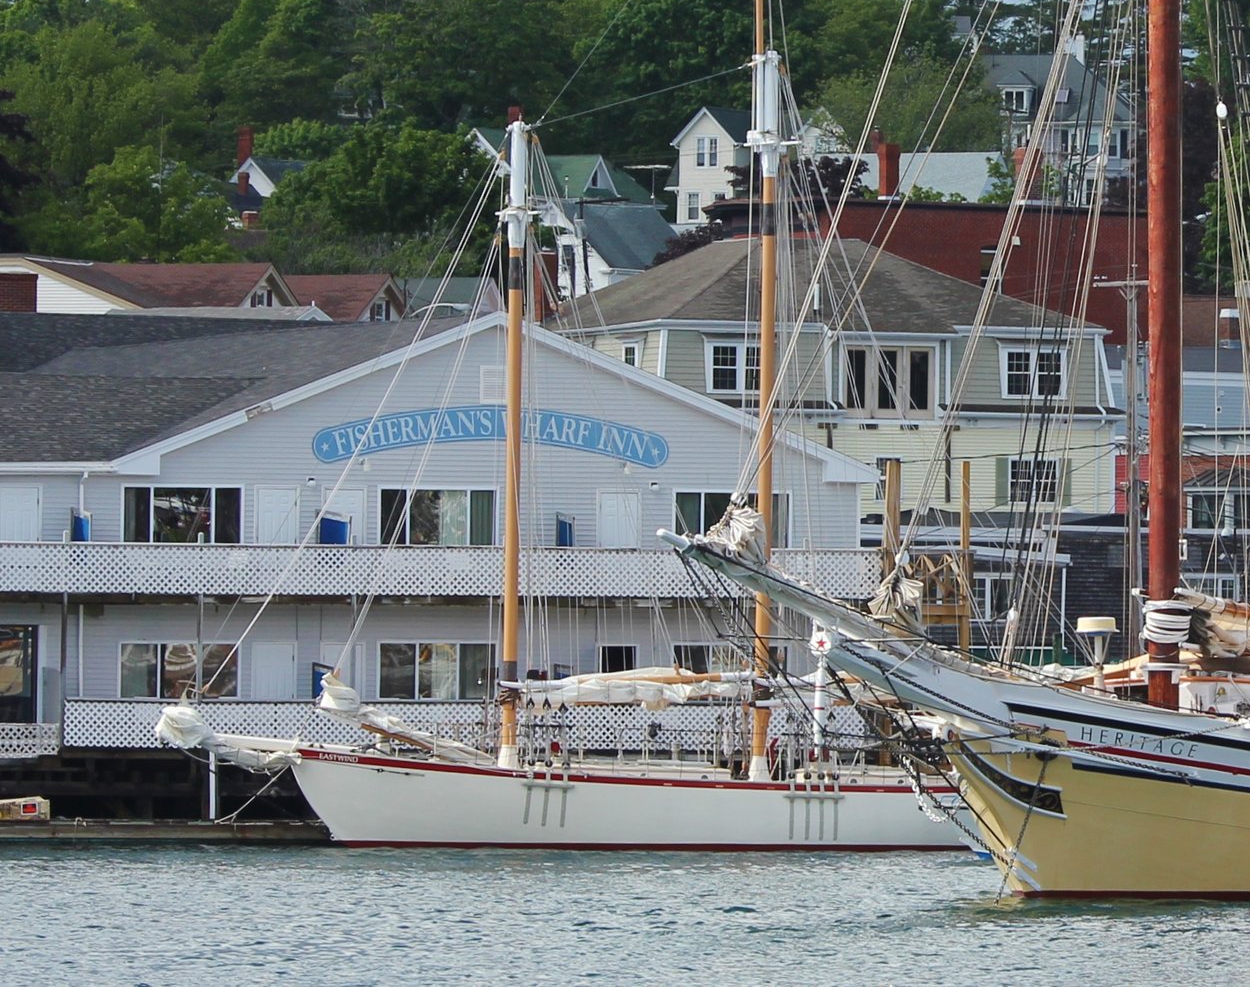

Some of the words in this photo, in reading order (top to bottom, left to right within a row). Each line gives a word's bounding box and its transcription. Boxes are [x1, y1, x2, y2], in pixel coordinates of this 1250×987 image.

[331, 409, 492, 456] FISHERMAN'S
[597, 428, 650, 460] INN
[319, 753, 359, 763] EASTWIND
[1081, 726, 1199, 758] HERITAGE
